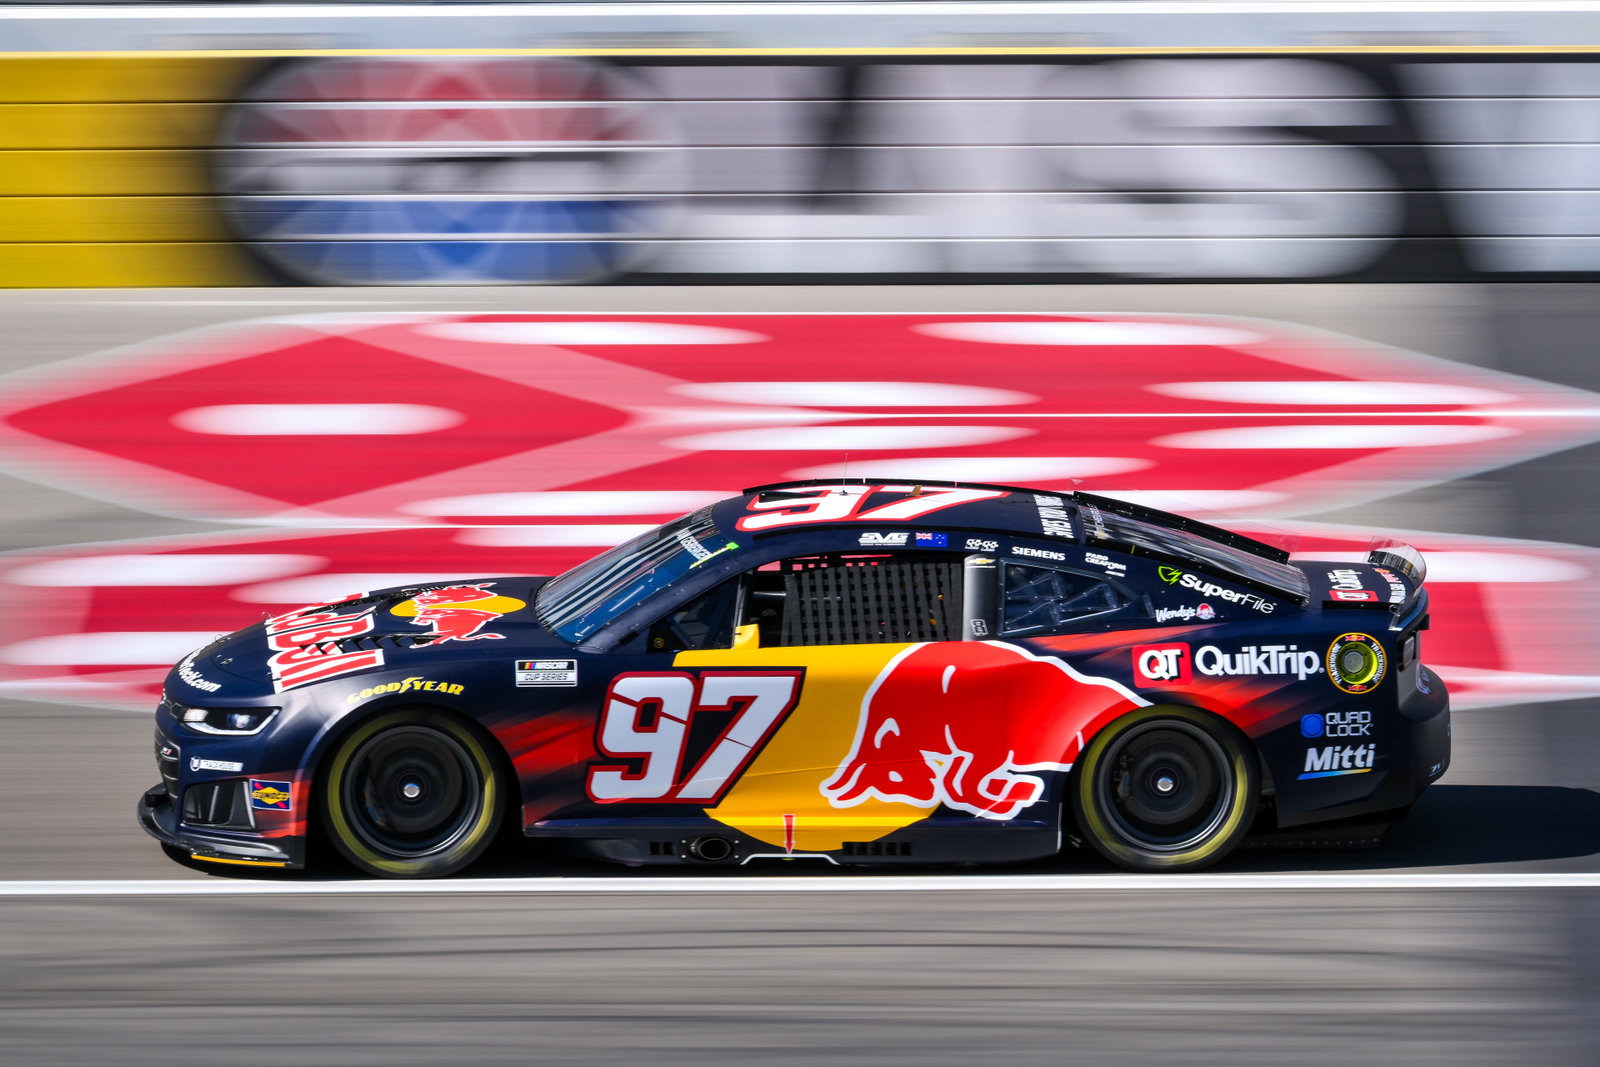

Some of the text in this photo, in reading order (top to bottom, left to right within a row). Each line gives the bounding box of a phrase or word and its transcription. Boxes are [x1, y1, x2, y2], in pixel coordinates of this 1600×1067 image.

[734, 484, 1013, 532] 97
[858, 532, 910, 544] SVG
[1011, 546, 1066, 561] SIEMENS
[1154, 604, 1197, 623] Wendy's
[1138, 645, 1321, 681] QT QuikTrip
[346, 676, 465, 704] GOODYEAR
[1325, 711, 1372, 725] QUAD
[586, 671, 803, 805] 97
[1325, 723, 1372, 737] LOCK
[1304, 743, 1376, 772] Mitti
